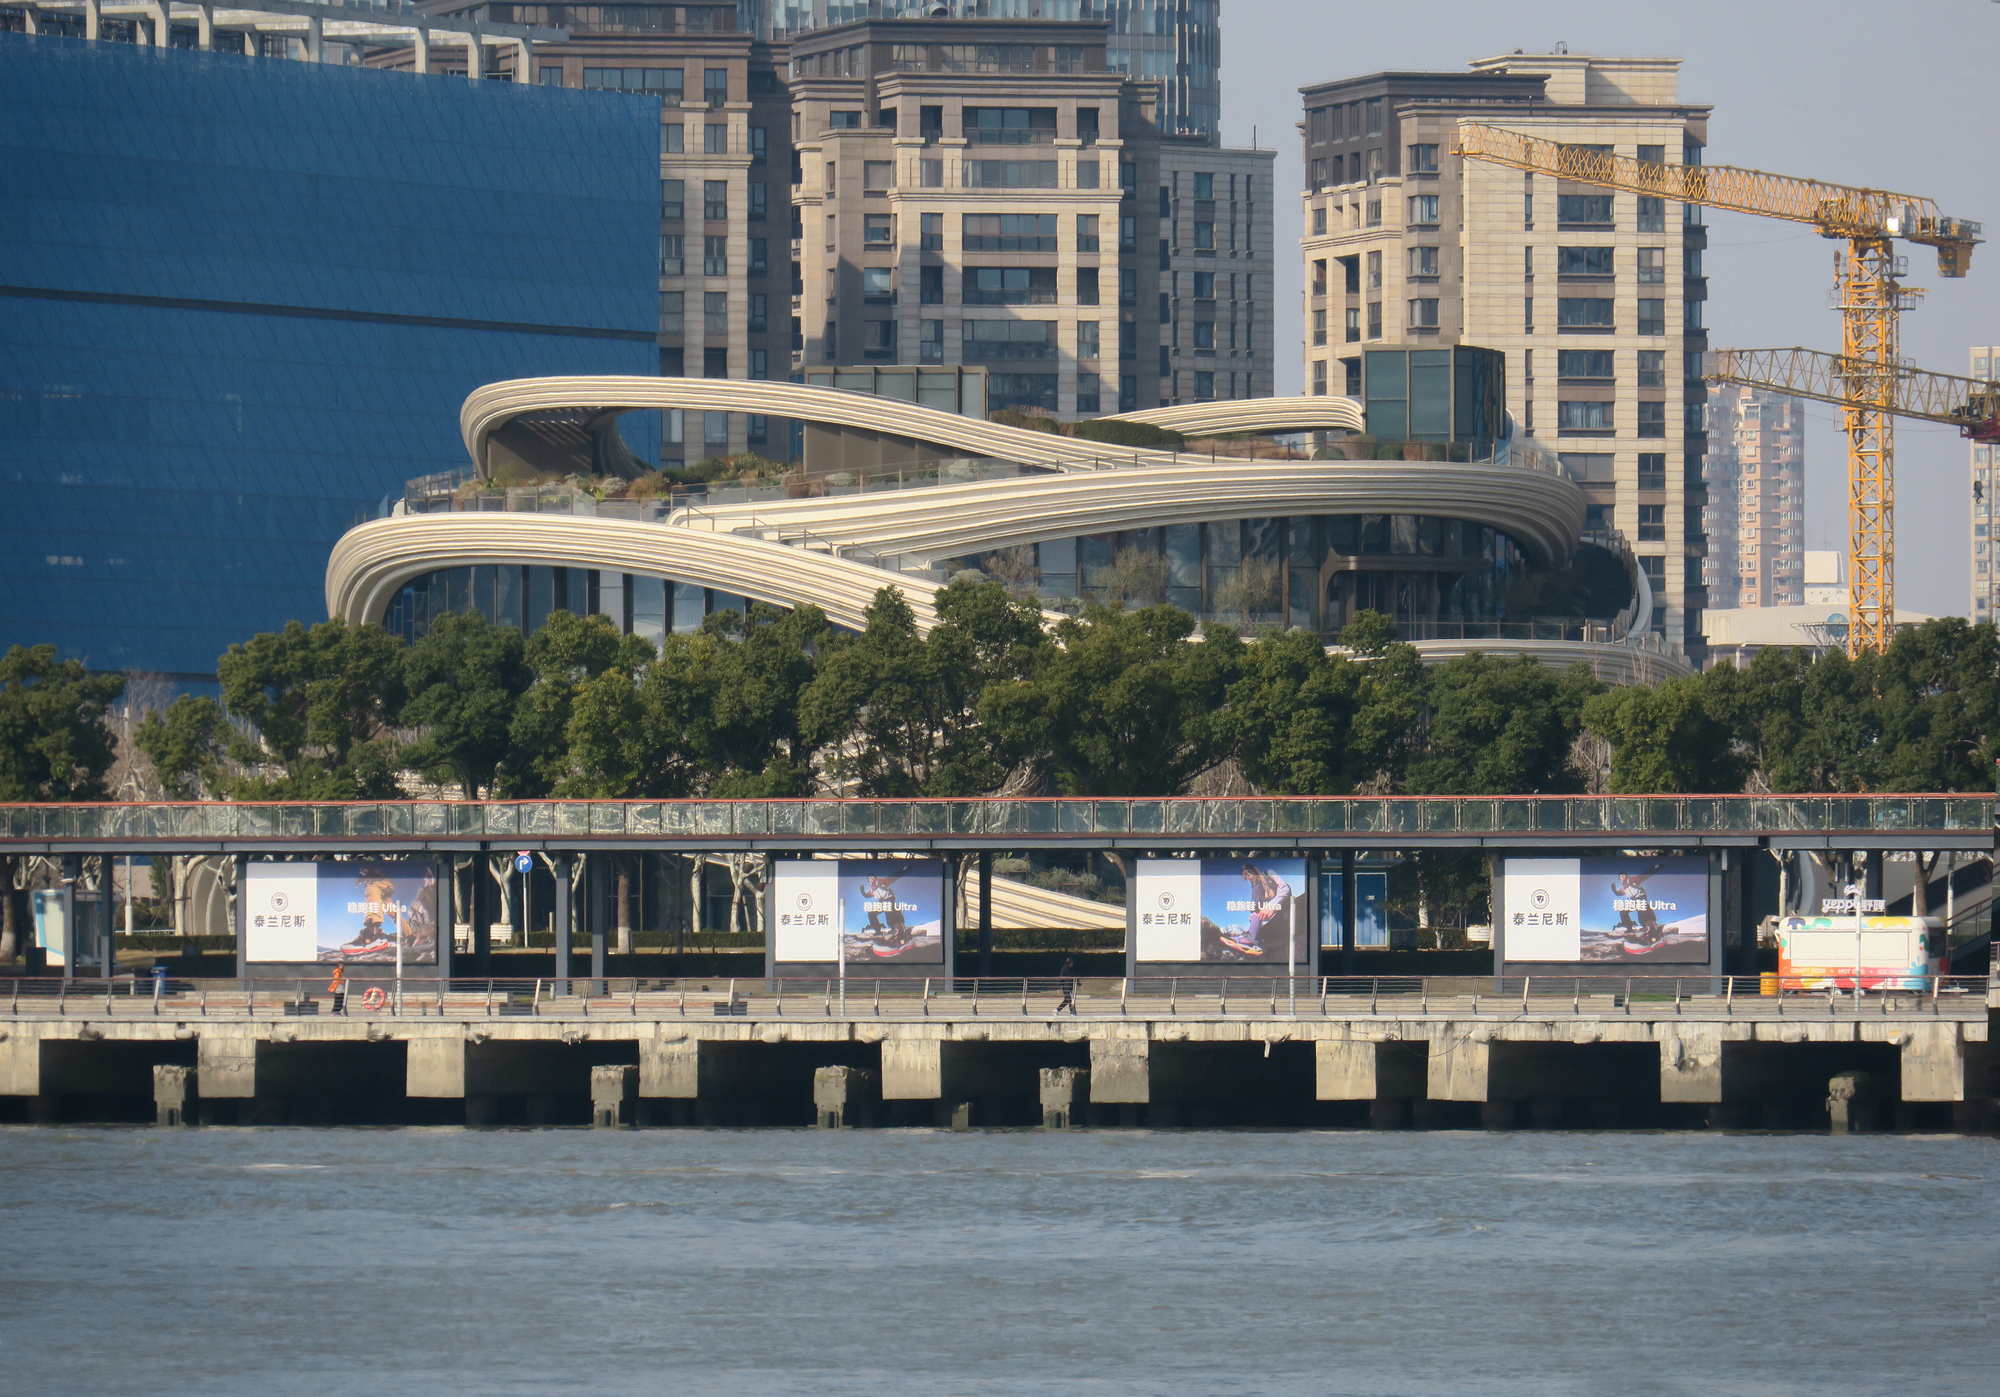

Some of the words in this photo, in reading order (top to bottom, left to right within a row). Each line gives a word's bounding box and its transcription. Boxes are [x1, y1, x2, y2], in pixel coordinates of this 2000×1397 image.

[347, 902, 379, 914] 稳跑鞋
[382, 903, 407, 913] Ulta
[863, 902, 892, 912] 稳跑鞋
[894, 903, 917, 911] Ultra
[1226, 901, 1256, 911] 稳跑鞋
[1258, 902, 1281, 911] Ultra
[1612, 899, 1647, 912] 稳跑鞋
[1650, 901, 1676, 910] Ultra
[254, 915, 306, 928] 泰兰尼斯
[780, 914, 829, 926] 泰兰尼斯
[1142, 913, 1192, 926] 泰兰尼斯
[1513, 913, 1568, 926] 泰兰尼斯
